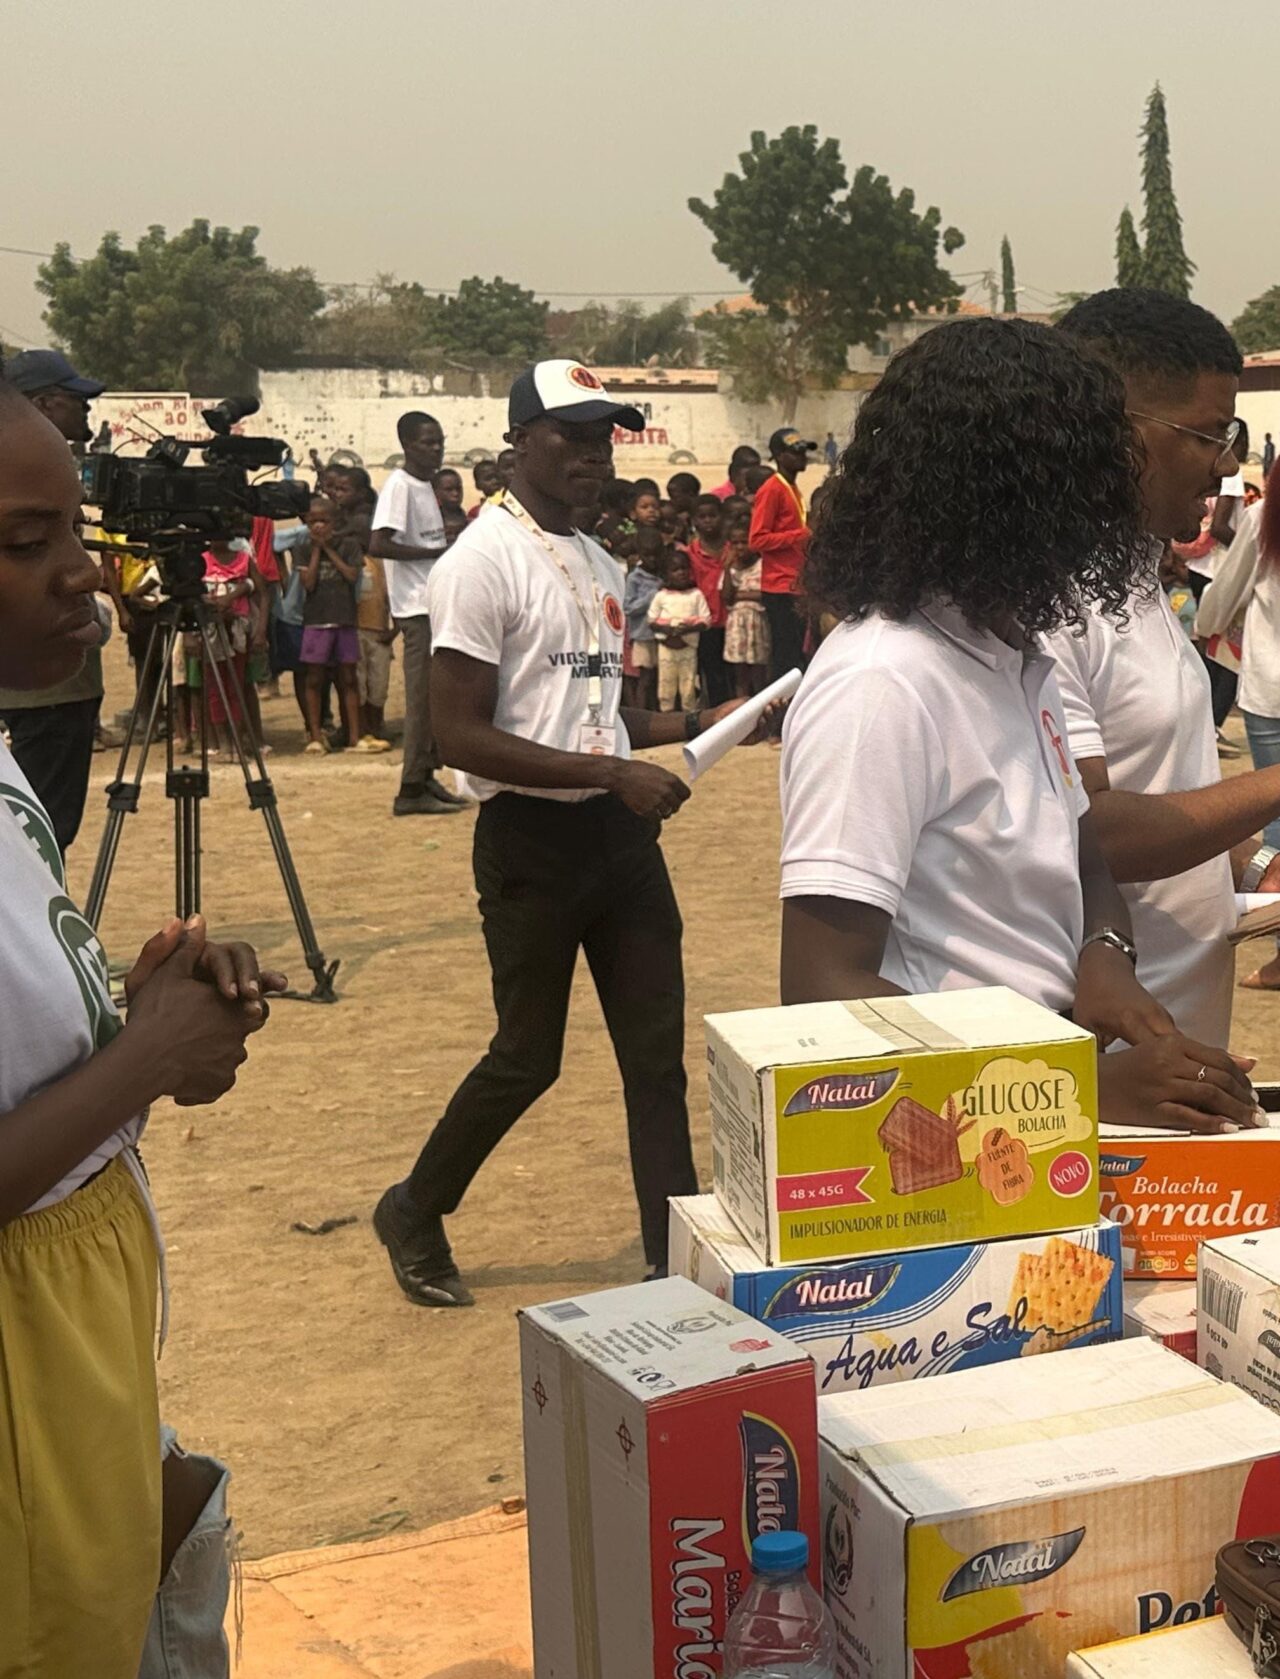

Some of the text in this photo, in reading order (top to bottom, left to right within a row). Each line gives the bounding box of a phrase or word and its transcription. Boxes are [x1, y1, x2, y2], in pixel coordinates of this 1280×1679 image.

[807, 1080, 875, 1104] Natal
[962, 1078, 1065, 1117] GLUCOSE
[1018, 1114, 1067, 1133] BOLACHA
[1000, 1163, 1013, 1175] DE
[1054, 1161, 1086, 1186] NOVO
[789, 1189, 805, 1200] 48
[818, 1184, 844, 1197] 45G
[1002, 1174, 1025, 1190] FIBRA
[1132, 1176, 1219, 1195] Bolacha
[1099, 1190, 1269, 1227] Torrada
[790, 1215, 882, 1239] IMPULSIONADOR
[886, 1214, 899, 1229] DE
[796, 1273, 872, 1305] Natal
[822, 1296, 1029, 1389] Água e Sal
[755, 1445, 788, 1534] Nata
[972, 1545, 1056, 1585] Natal
[670, 1517, 726, 1679] Maria
